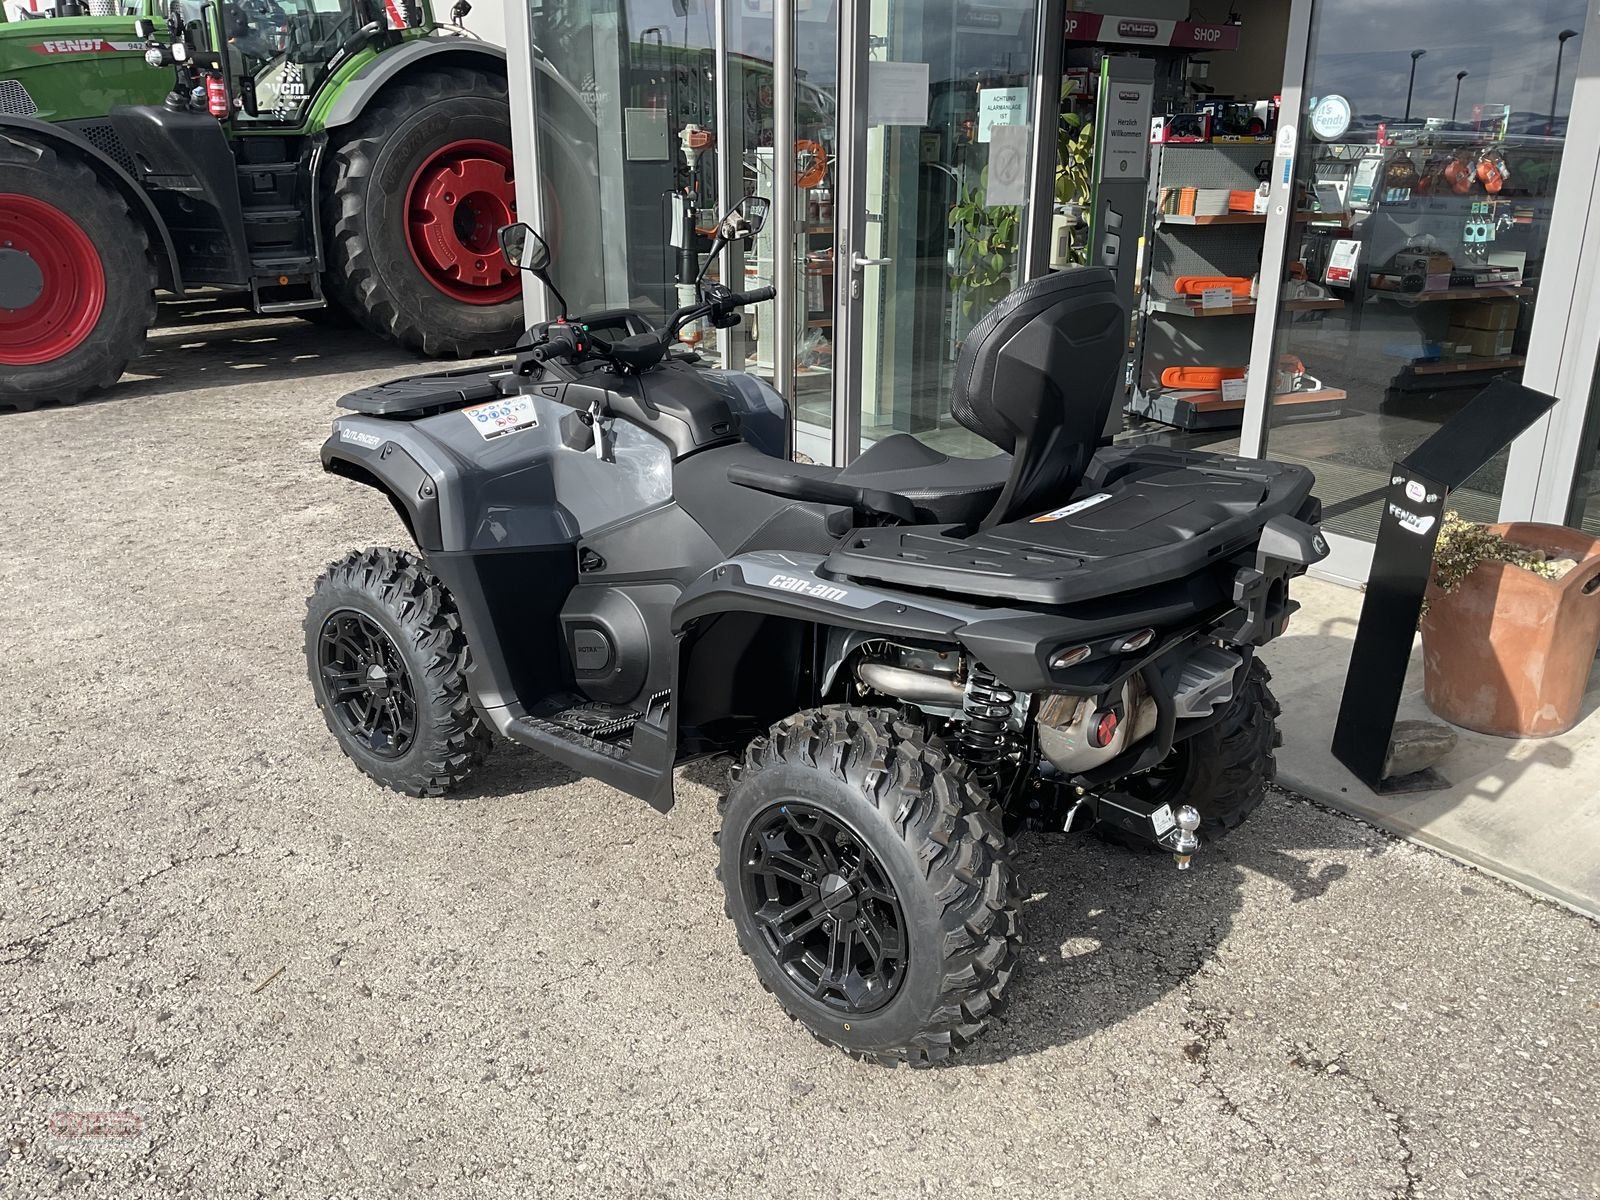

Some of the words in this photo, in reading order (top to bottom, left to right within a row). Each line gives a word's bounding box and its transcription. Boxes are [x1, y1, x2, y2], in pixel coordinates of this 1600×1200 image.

[1065, 19, 1078, 33] OP
[1194, 27, 1221, 42] SHOP
[43, 38, 103, 53] FENDT
[1316, 114, 1343, 125] Fendt
[1111, 129, 1142, 138] Willkommen
[342, 428, 380, 446] OUTLANDER
[768, 574, 848, 601] can-am
